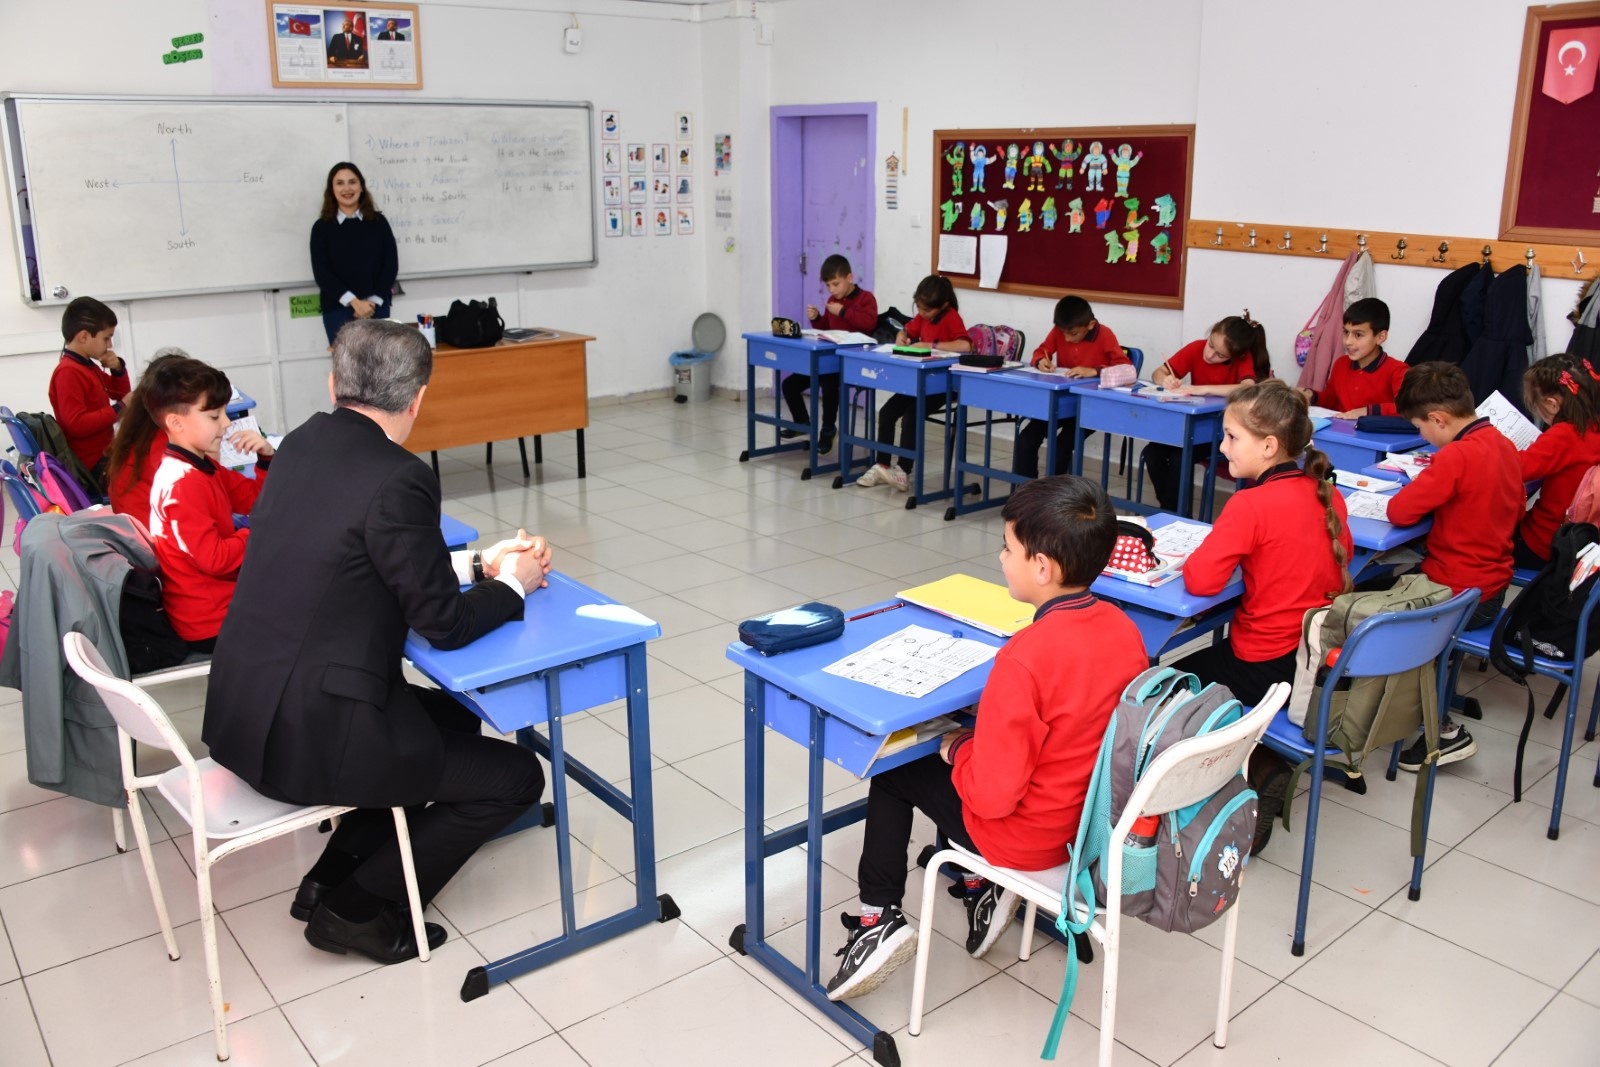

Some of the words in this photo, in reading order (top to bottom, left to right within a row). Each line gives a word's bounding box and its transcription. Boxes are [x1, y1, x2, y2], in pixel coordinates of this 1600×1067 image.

[157, 122, 192, 135] North
[378, 136, 409, 150] Where
[84, 179, 110, 189] West
[243, 172, 264, 184] East
[421, 191, 436, 203] the
[441, 189, 469, 202] South
[167, 238, 196, 250] South
[850, 940, 864, 956] NIKE
